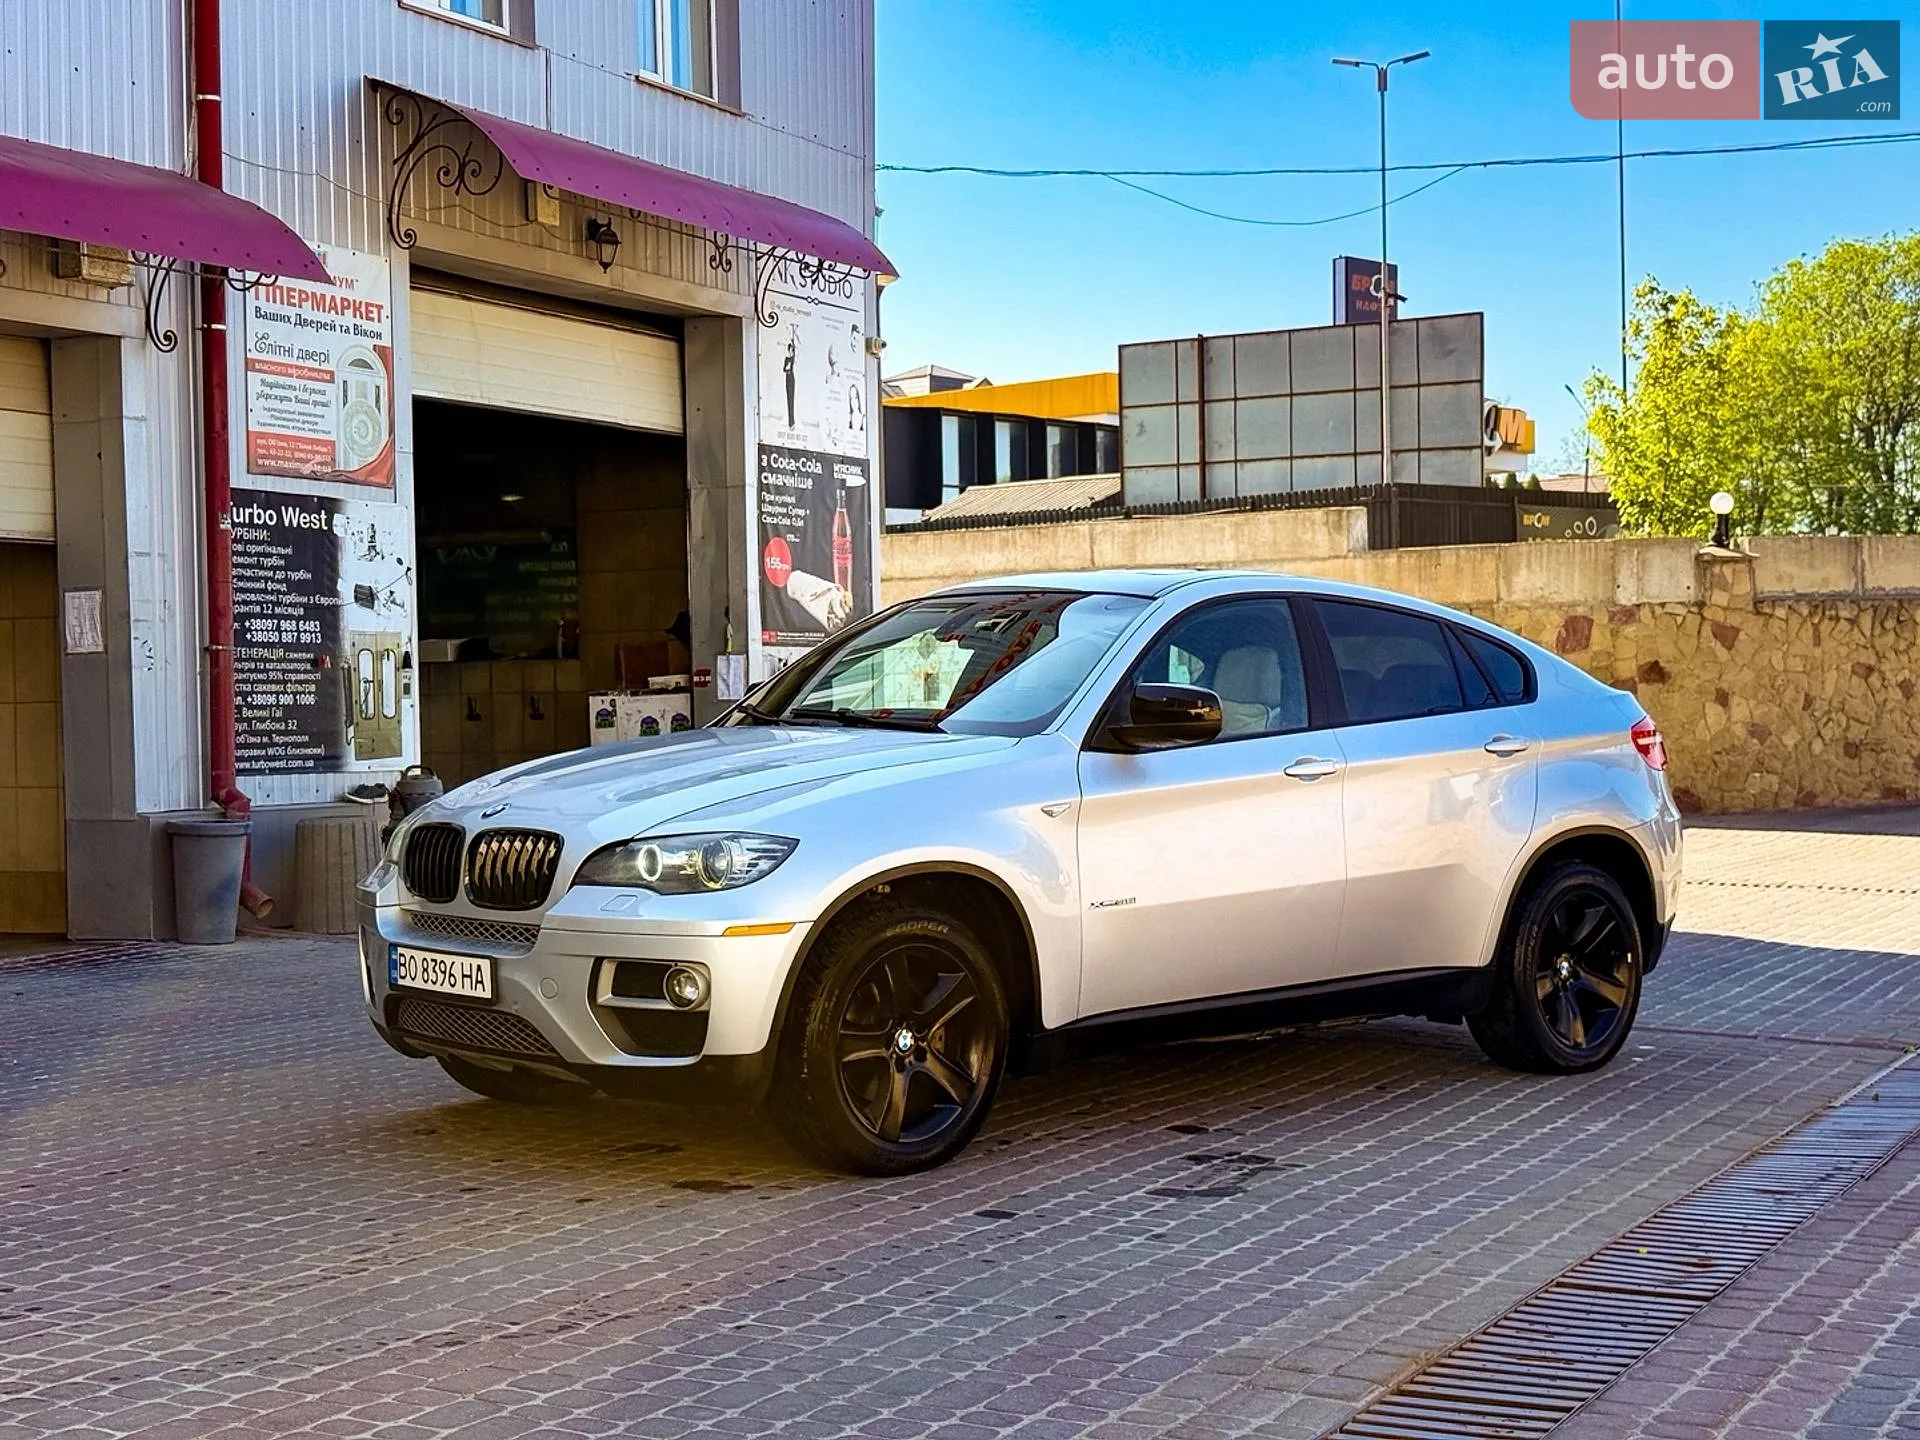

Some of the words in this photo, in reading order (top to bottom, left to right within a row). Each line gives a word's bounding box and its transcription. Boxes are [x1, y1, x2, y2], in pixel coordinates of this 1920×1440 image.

[254, 284, 384, 324] ГІПЕРМАРКЕТ
[254, 305, 292, 324] Ваших
[294, 313, 336, 333] Дверей
[339, 323, 351, 335] та
[353, 323, 383, 341] Вікон
[254, 331, 294, 359] Елітні
[296, 348, 330, 366] двері
[761, 454, 768, 467] з
[770, 453, 823, 475] Coca-Cola
[761, 472, 813, 490] смачніше
[230, 501, 277, 526] urbo
[281, 505, 328, 530] West
[230, 526, 271, 541] УРБІНИ:
[232, 542, 245, 552] ові
[232, 555, 258, 565] емонт
[232, 567, 273, 578] апчастини
[232, 578, 265, 589] бмінний
[234, 603, 261, 616] рантія
[262, 603, 273, 614] 12
[244, 618, 279, 631] +38097
[300, 632, 322, 644] 9913
[268, 671, 284, 680] 95%
[235, 683, 252, 692] стка
[242, 707, 271, 718] Великі
[287, 719, 298, 731] 32
[399, 952, 418, 982] BO
[421, 957, 457, 988] 8396
[461, 961, 486, 992] HA
